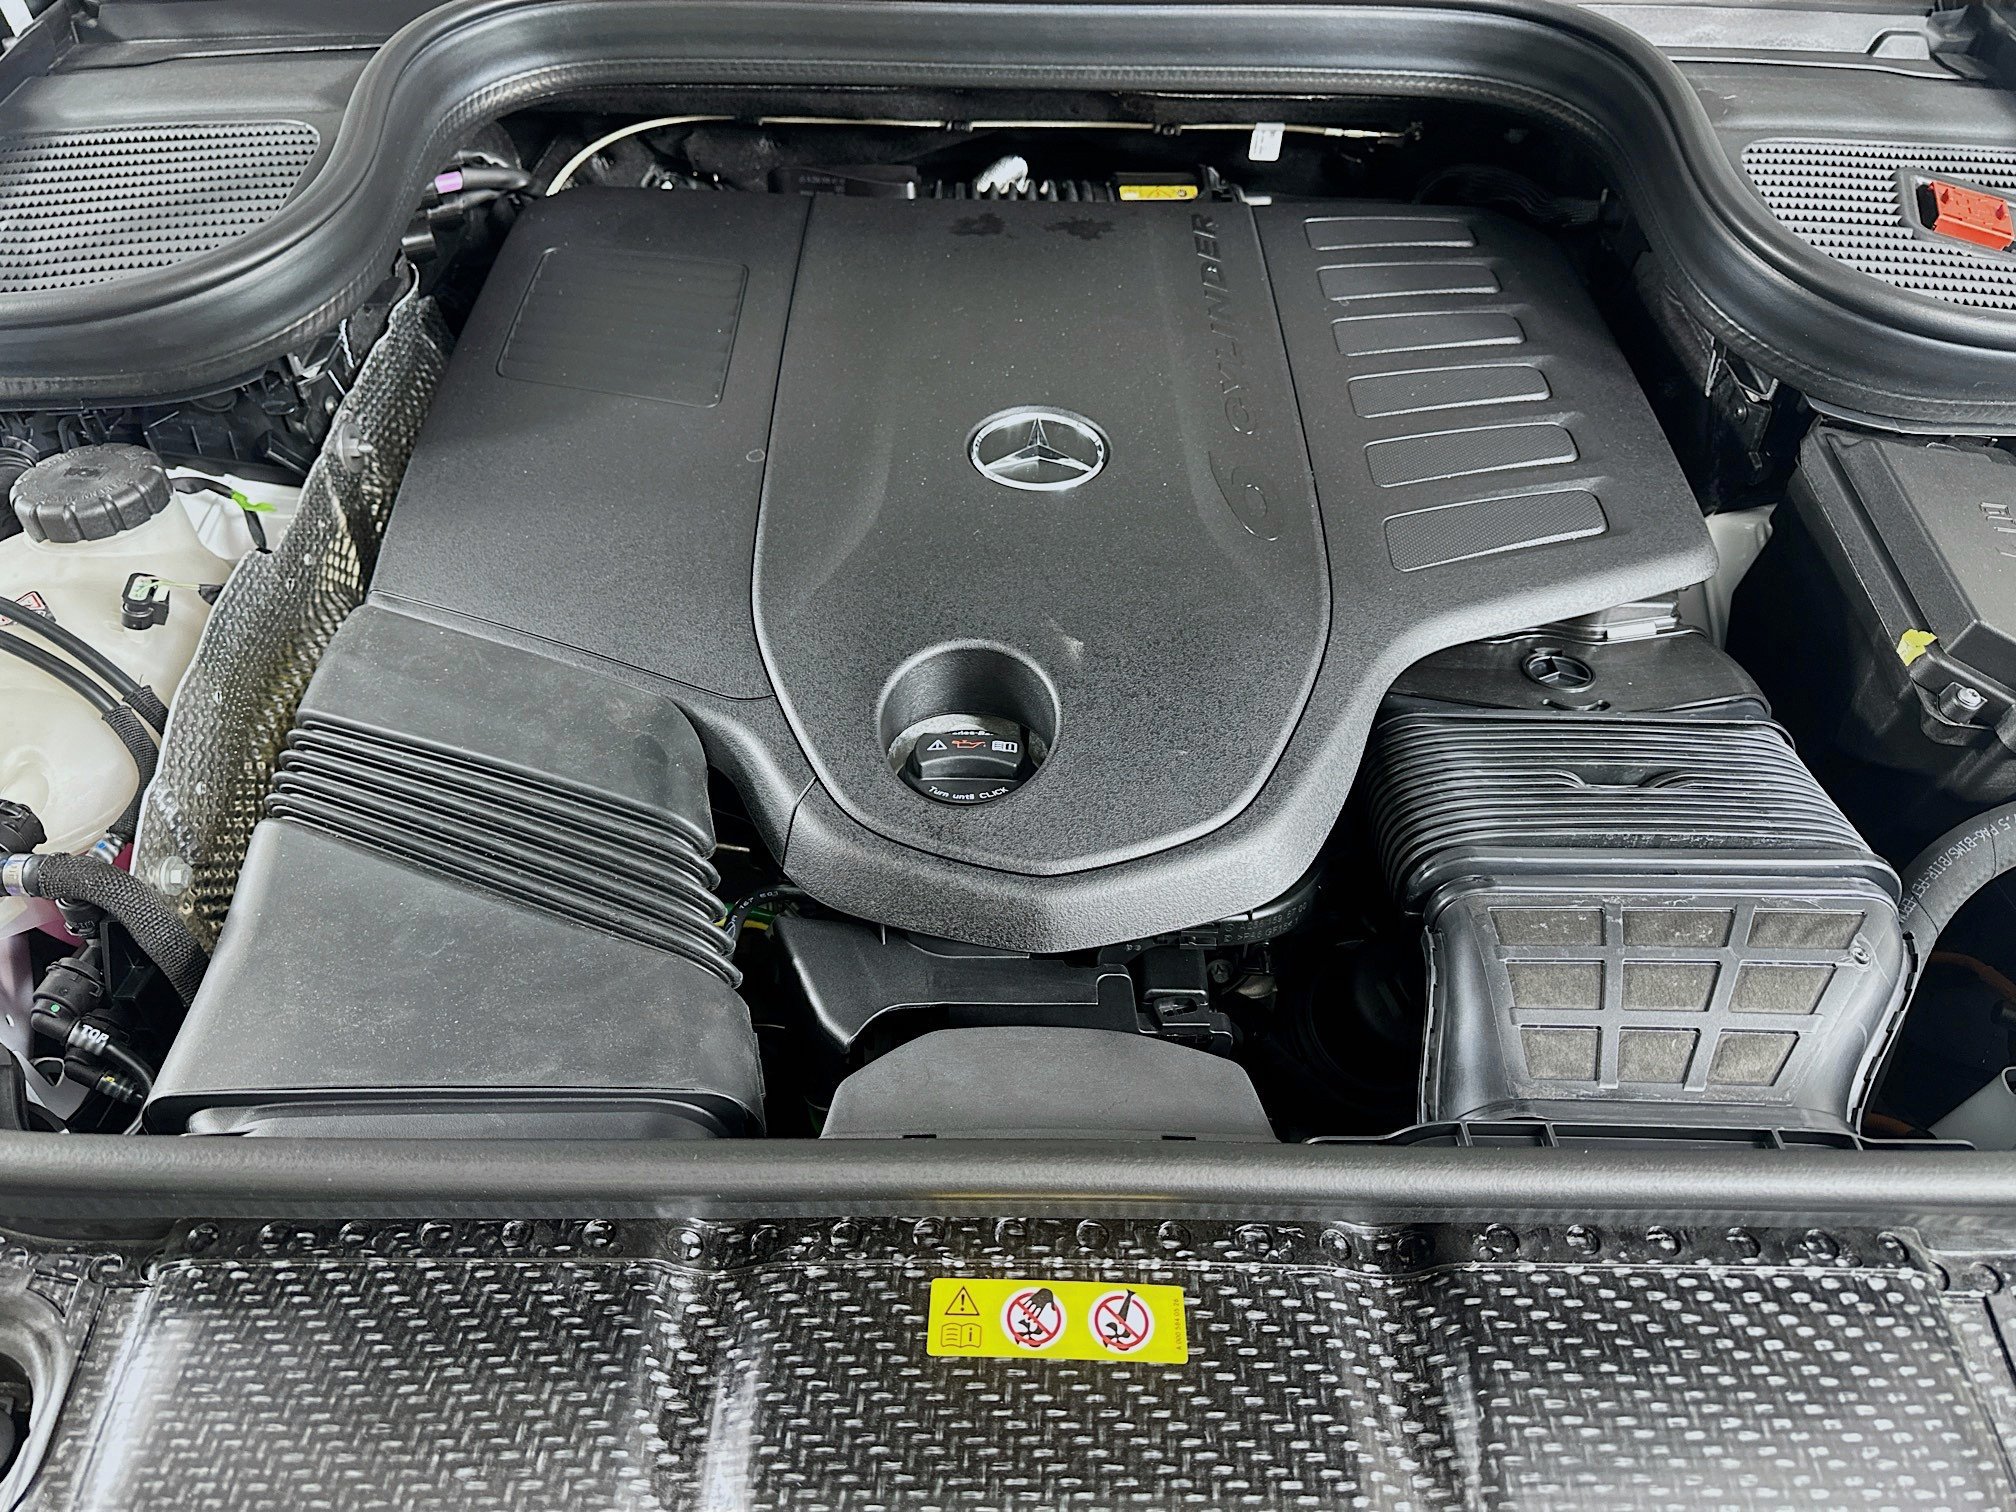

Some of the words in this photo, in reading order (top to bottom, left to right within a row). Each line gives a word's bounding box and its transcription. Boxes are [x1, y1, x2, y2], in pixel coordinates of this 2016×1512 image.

[1190, 213, 1256, 434] CYLINDER
[928, 785, 950, 798] Turn
[979, 786, 1009, 799] CLICK
[81, 1023, 110, 1047] TOP
